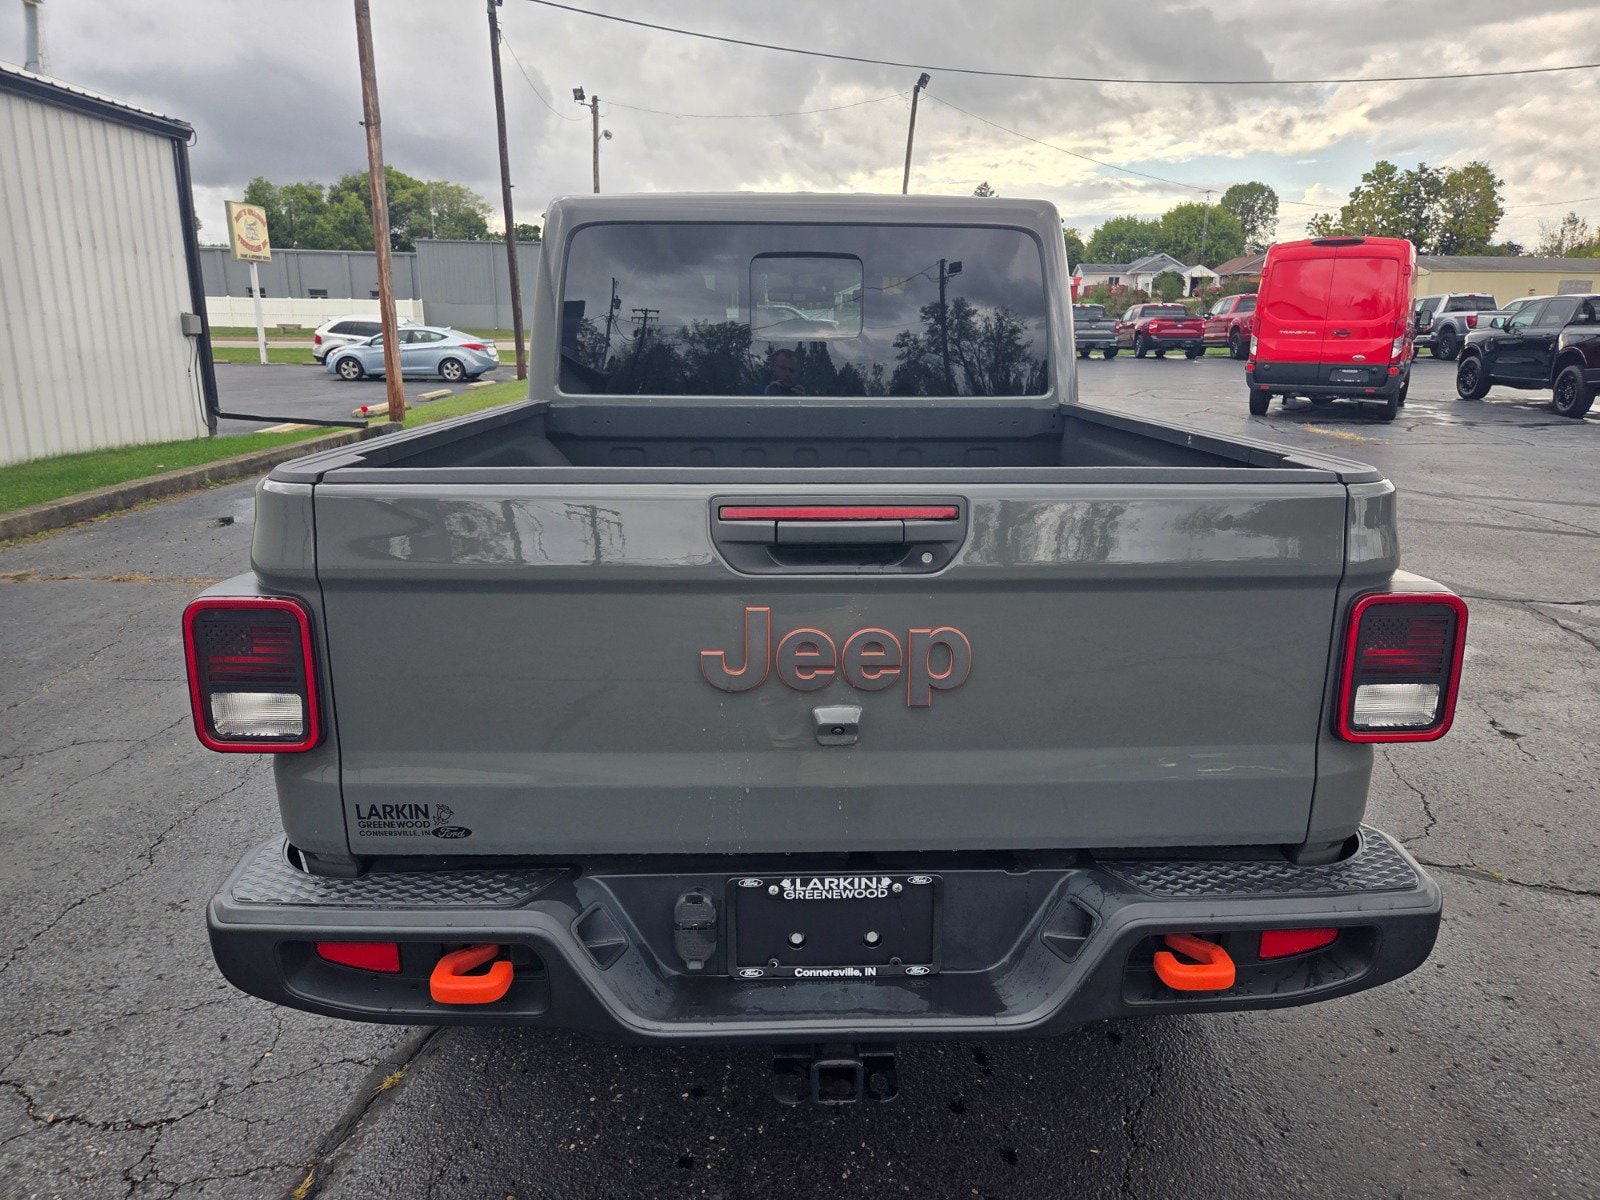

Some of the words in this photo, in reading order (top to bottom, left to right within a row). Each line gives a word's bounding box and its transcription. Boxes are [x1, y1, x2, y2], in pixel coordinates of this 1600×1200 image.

[700, 607, 972, 708] Jeep
[356, 804, 430, 820] LARKIN
[358, 820, 431, 829] GREENEWOOD
[437, 827, 467, 839] Ford
[796, 877, 877, 891] LARKIN
[783, 889, 888, 900] GREENEWOOD
[794, 967, 862, 977] Connersville,
[864, 967, 876, 976] IN
